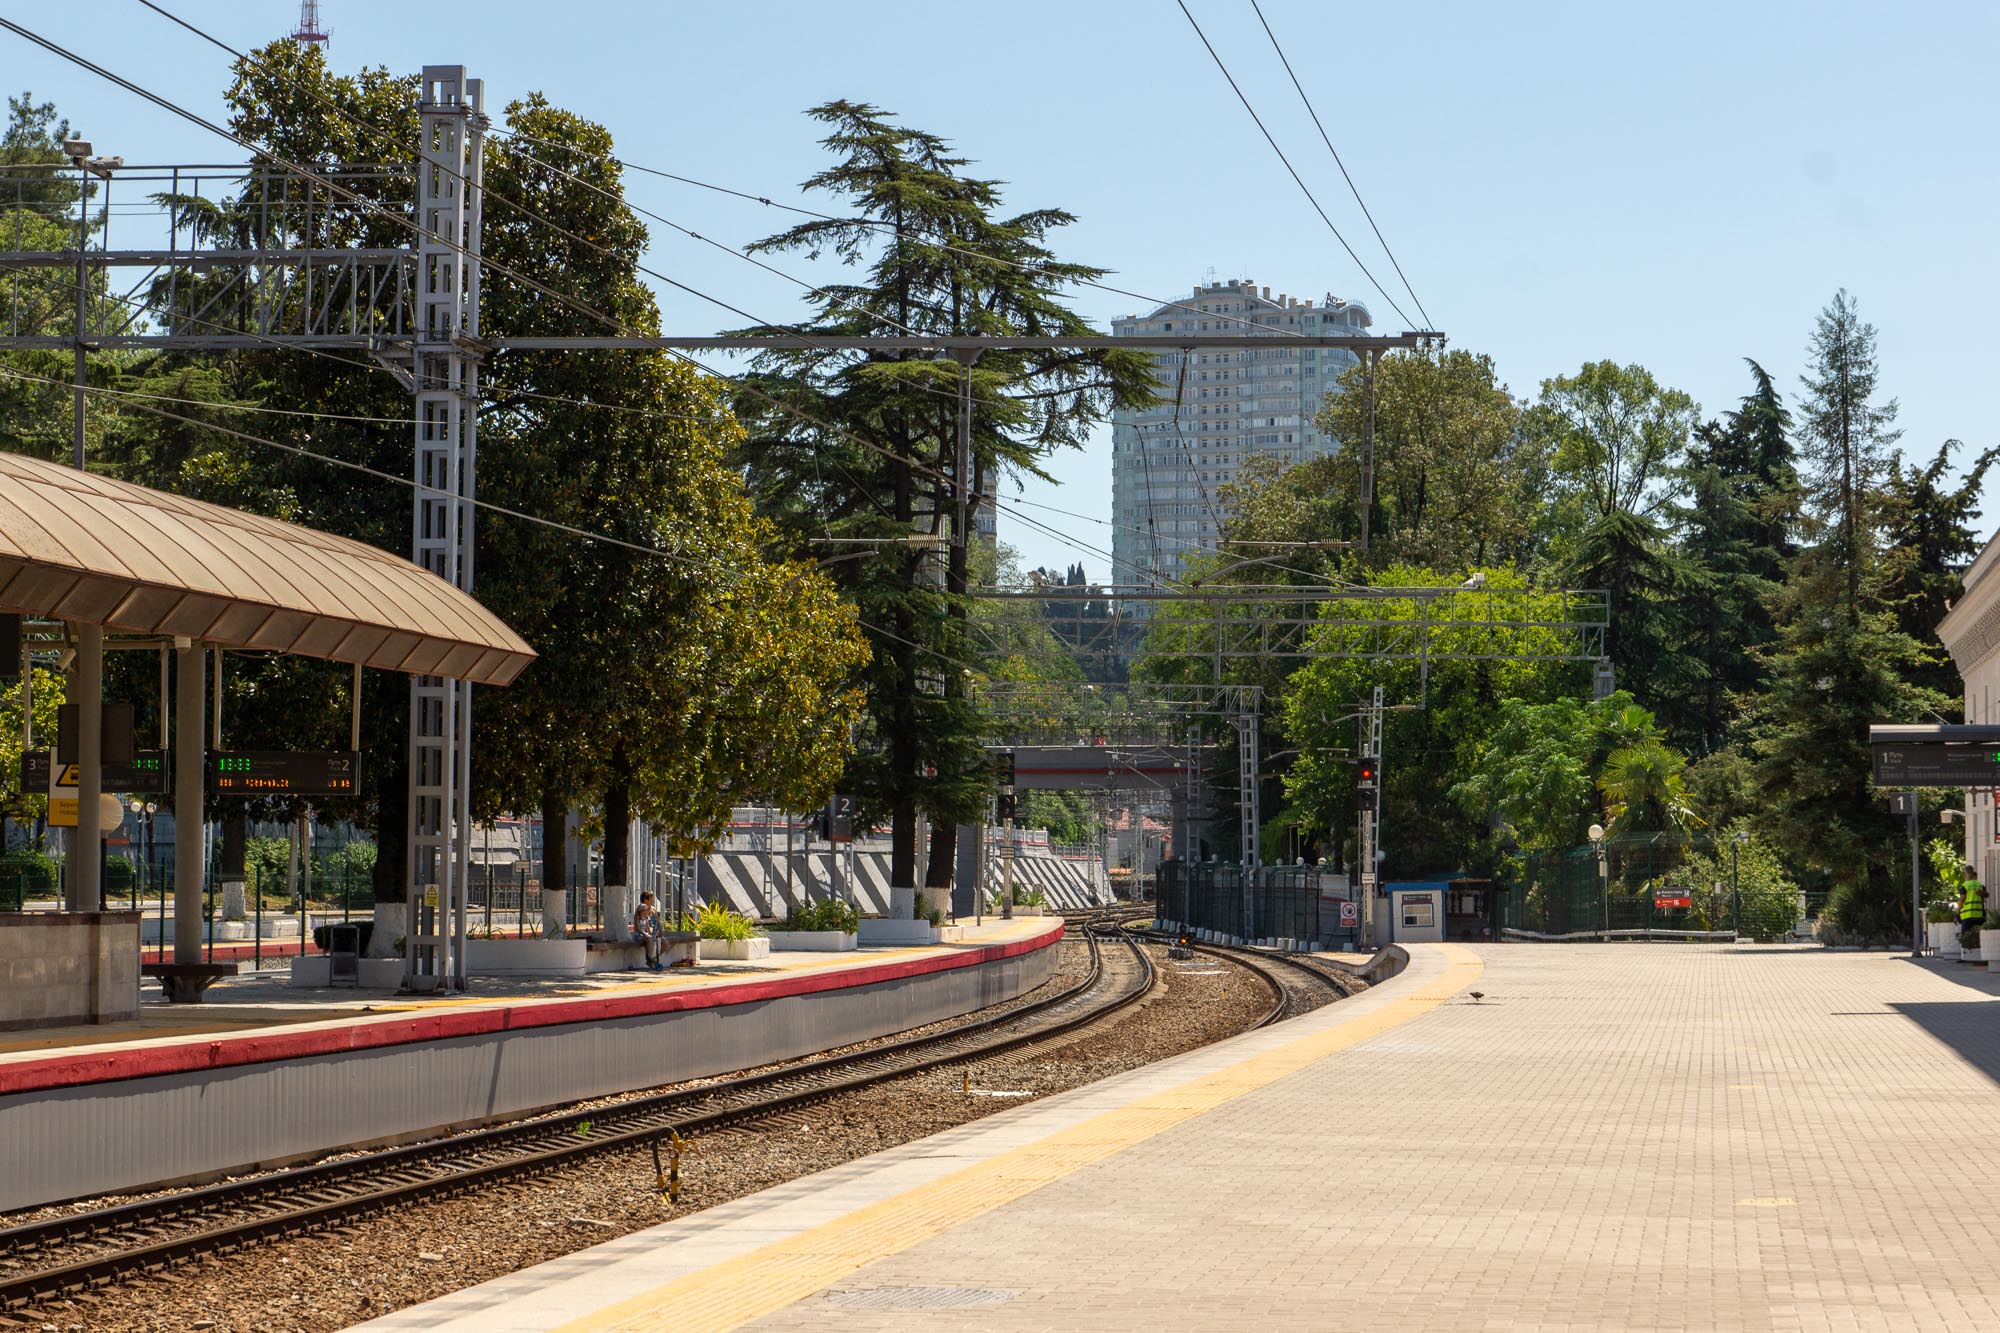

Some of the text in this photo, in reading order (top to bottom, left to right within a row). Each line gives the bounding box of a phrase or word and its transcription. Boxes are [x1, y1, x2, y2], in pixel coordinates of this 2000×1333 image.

[28, 758, 37, 770] 3
[1882, 752, 1888, 764] 1
[342, 759, 350, 771] 2
[841, 798, 850, 812] 2
[1897, 795, 1904, 811] 1
